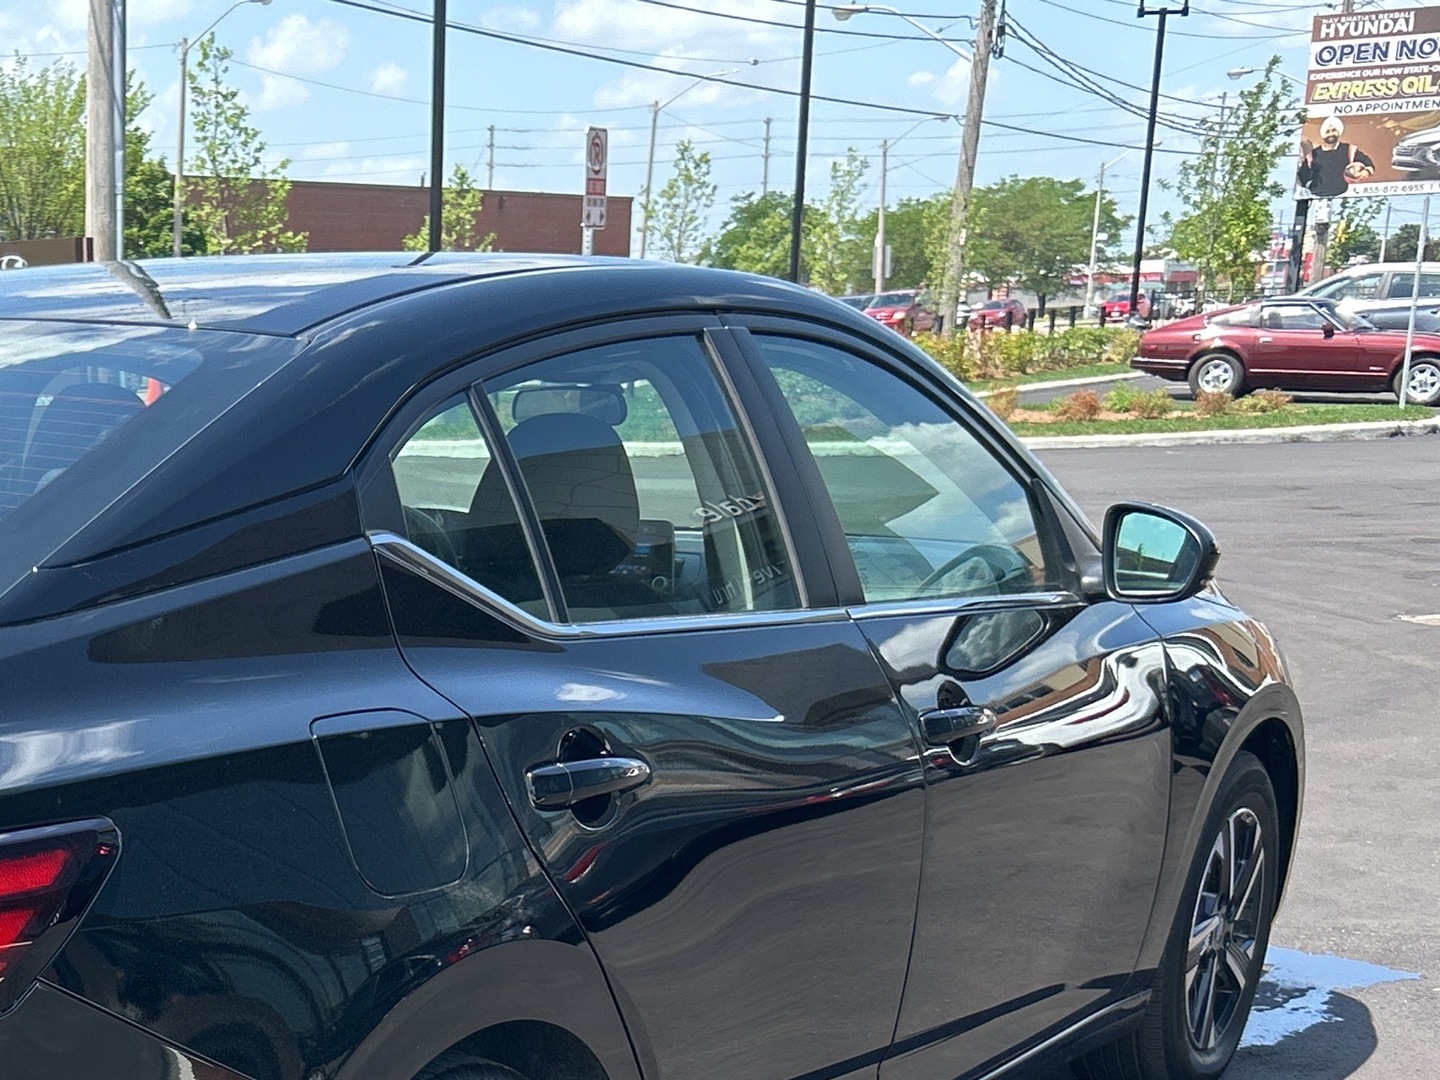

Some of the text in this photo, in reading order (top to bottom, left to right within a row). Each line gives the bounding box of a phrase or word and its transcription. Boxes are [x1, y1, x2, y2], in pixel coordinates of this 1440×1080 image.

[1320, 17, 1415, 39] HYUNDAI
[1316, 38, 1440, 65] OPEN NO
[1362, 68, 1380, 77] OUR
[1382, 67, 1403, 76] NEW
[1311, 77, 1400, 103] EXPRESS
[1400, 75, 1438, 96] OIL
[1334, 105, 1352, 114] NO
